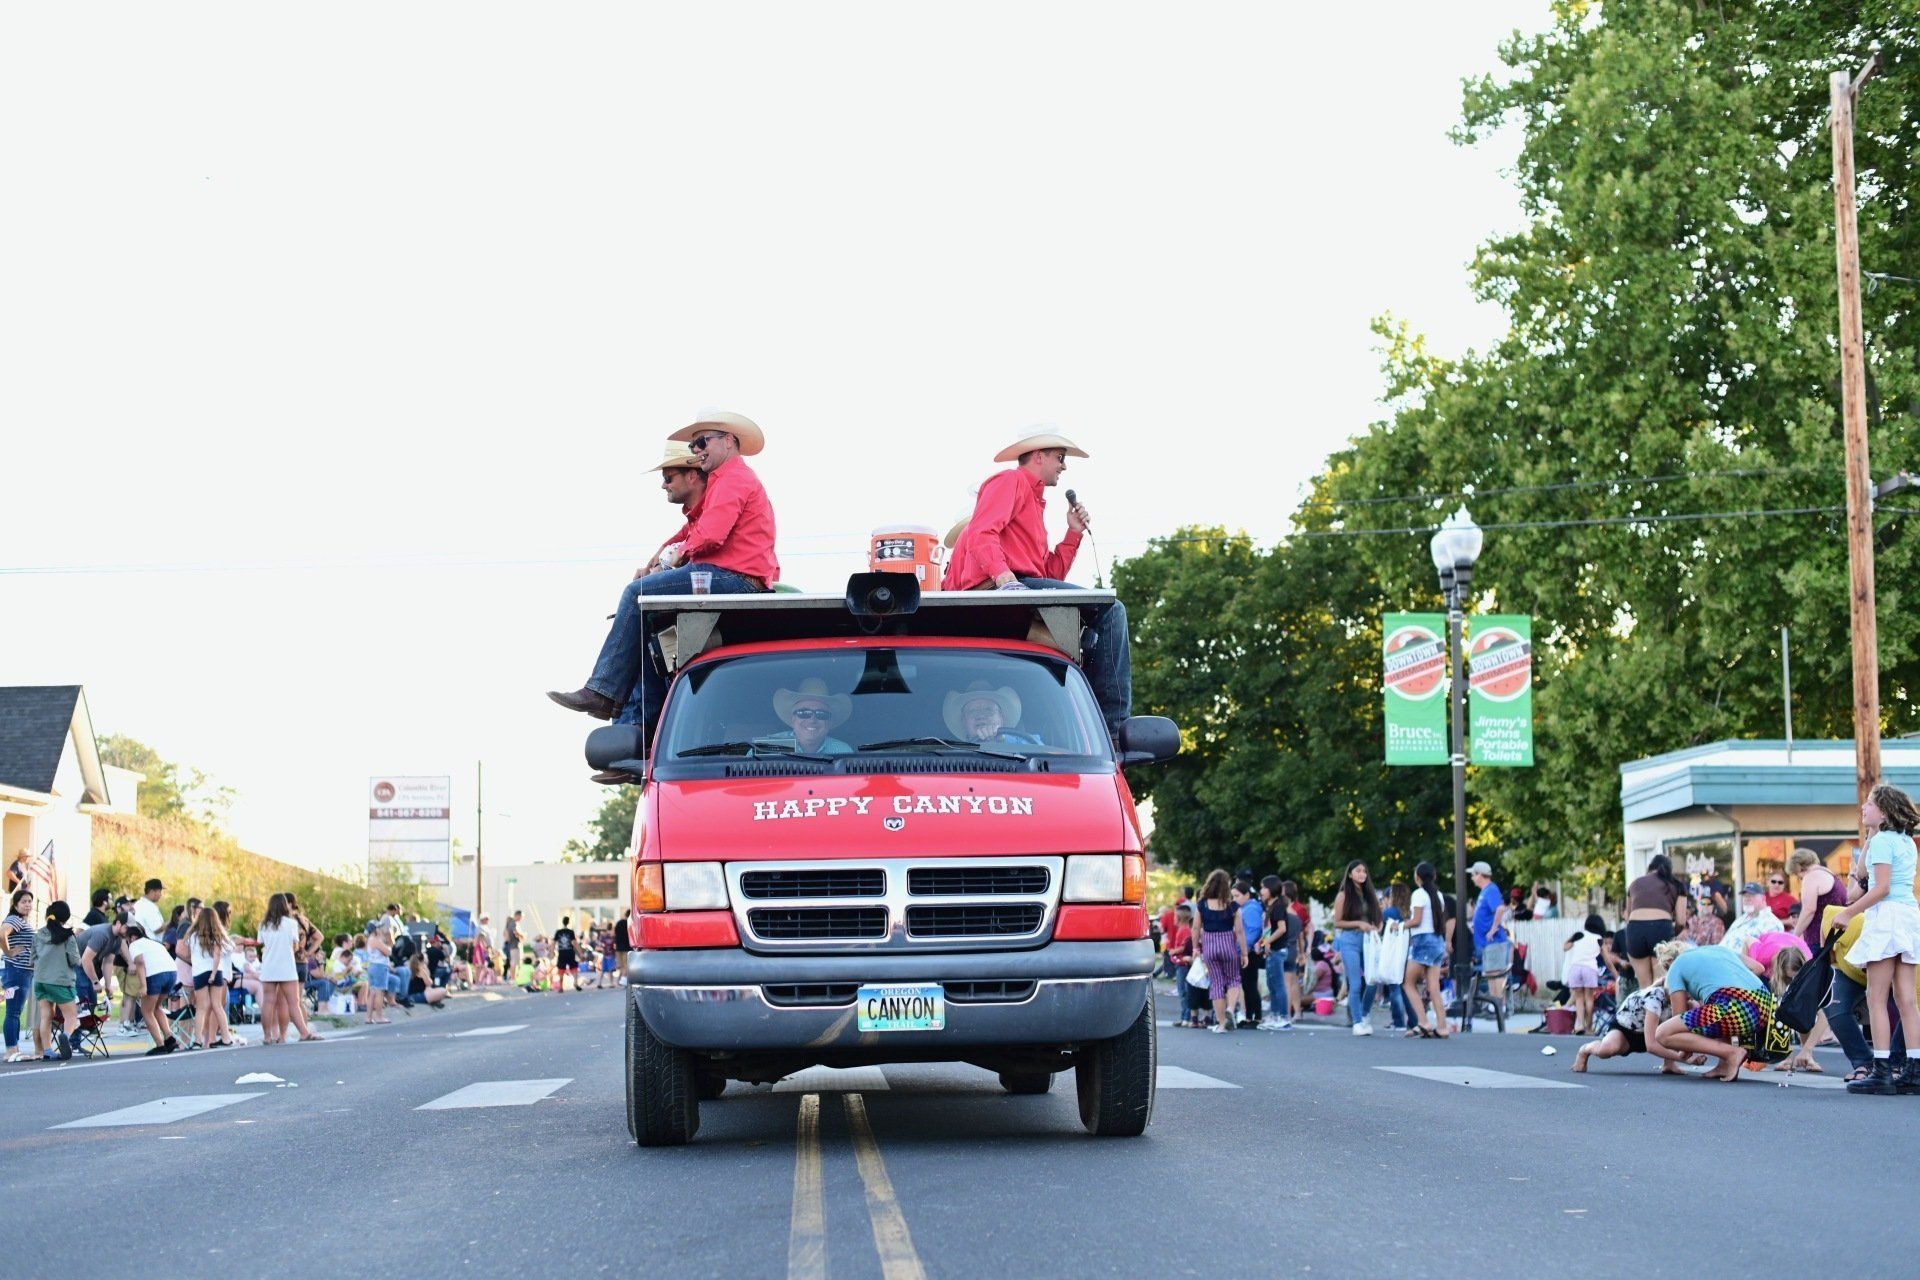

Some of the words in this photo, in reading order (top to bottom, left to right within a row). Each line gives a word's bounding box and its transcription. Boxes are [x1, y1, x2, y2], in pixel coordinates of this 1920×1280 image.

[1385, 644, 1438, 672] DOWNTOWN
[1471, 645, 1524, 673] DOWNTOWN
[1474, 716, 1528, 730] Jimmy's
[1389, 723, 1432, 738] Bruce
[1474, 737, 1529, 750] Portable
[1481, 749, 1523, 762] Toilets
[753, 796, 874, 821] HAPPY
[893, 795, 1034, 815] CANYON
[880, 987, 922, 996] OREGON
[867, 997, 935, 1021] CANYON
[888, 1021, 915, 1029] TRAIL
